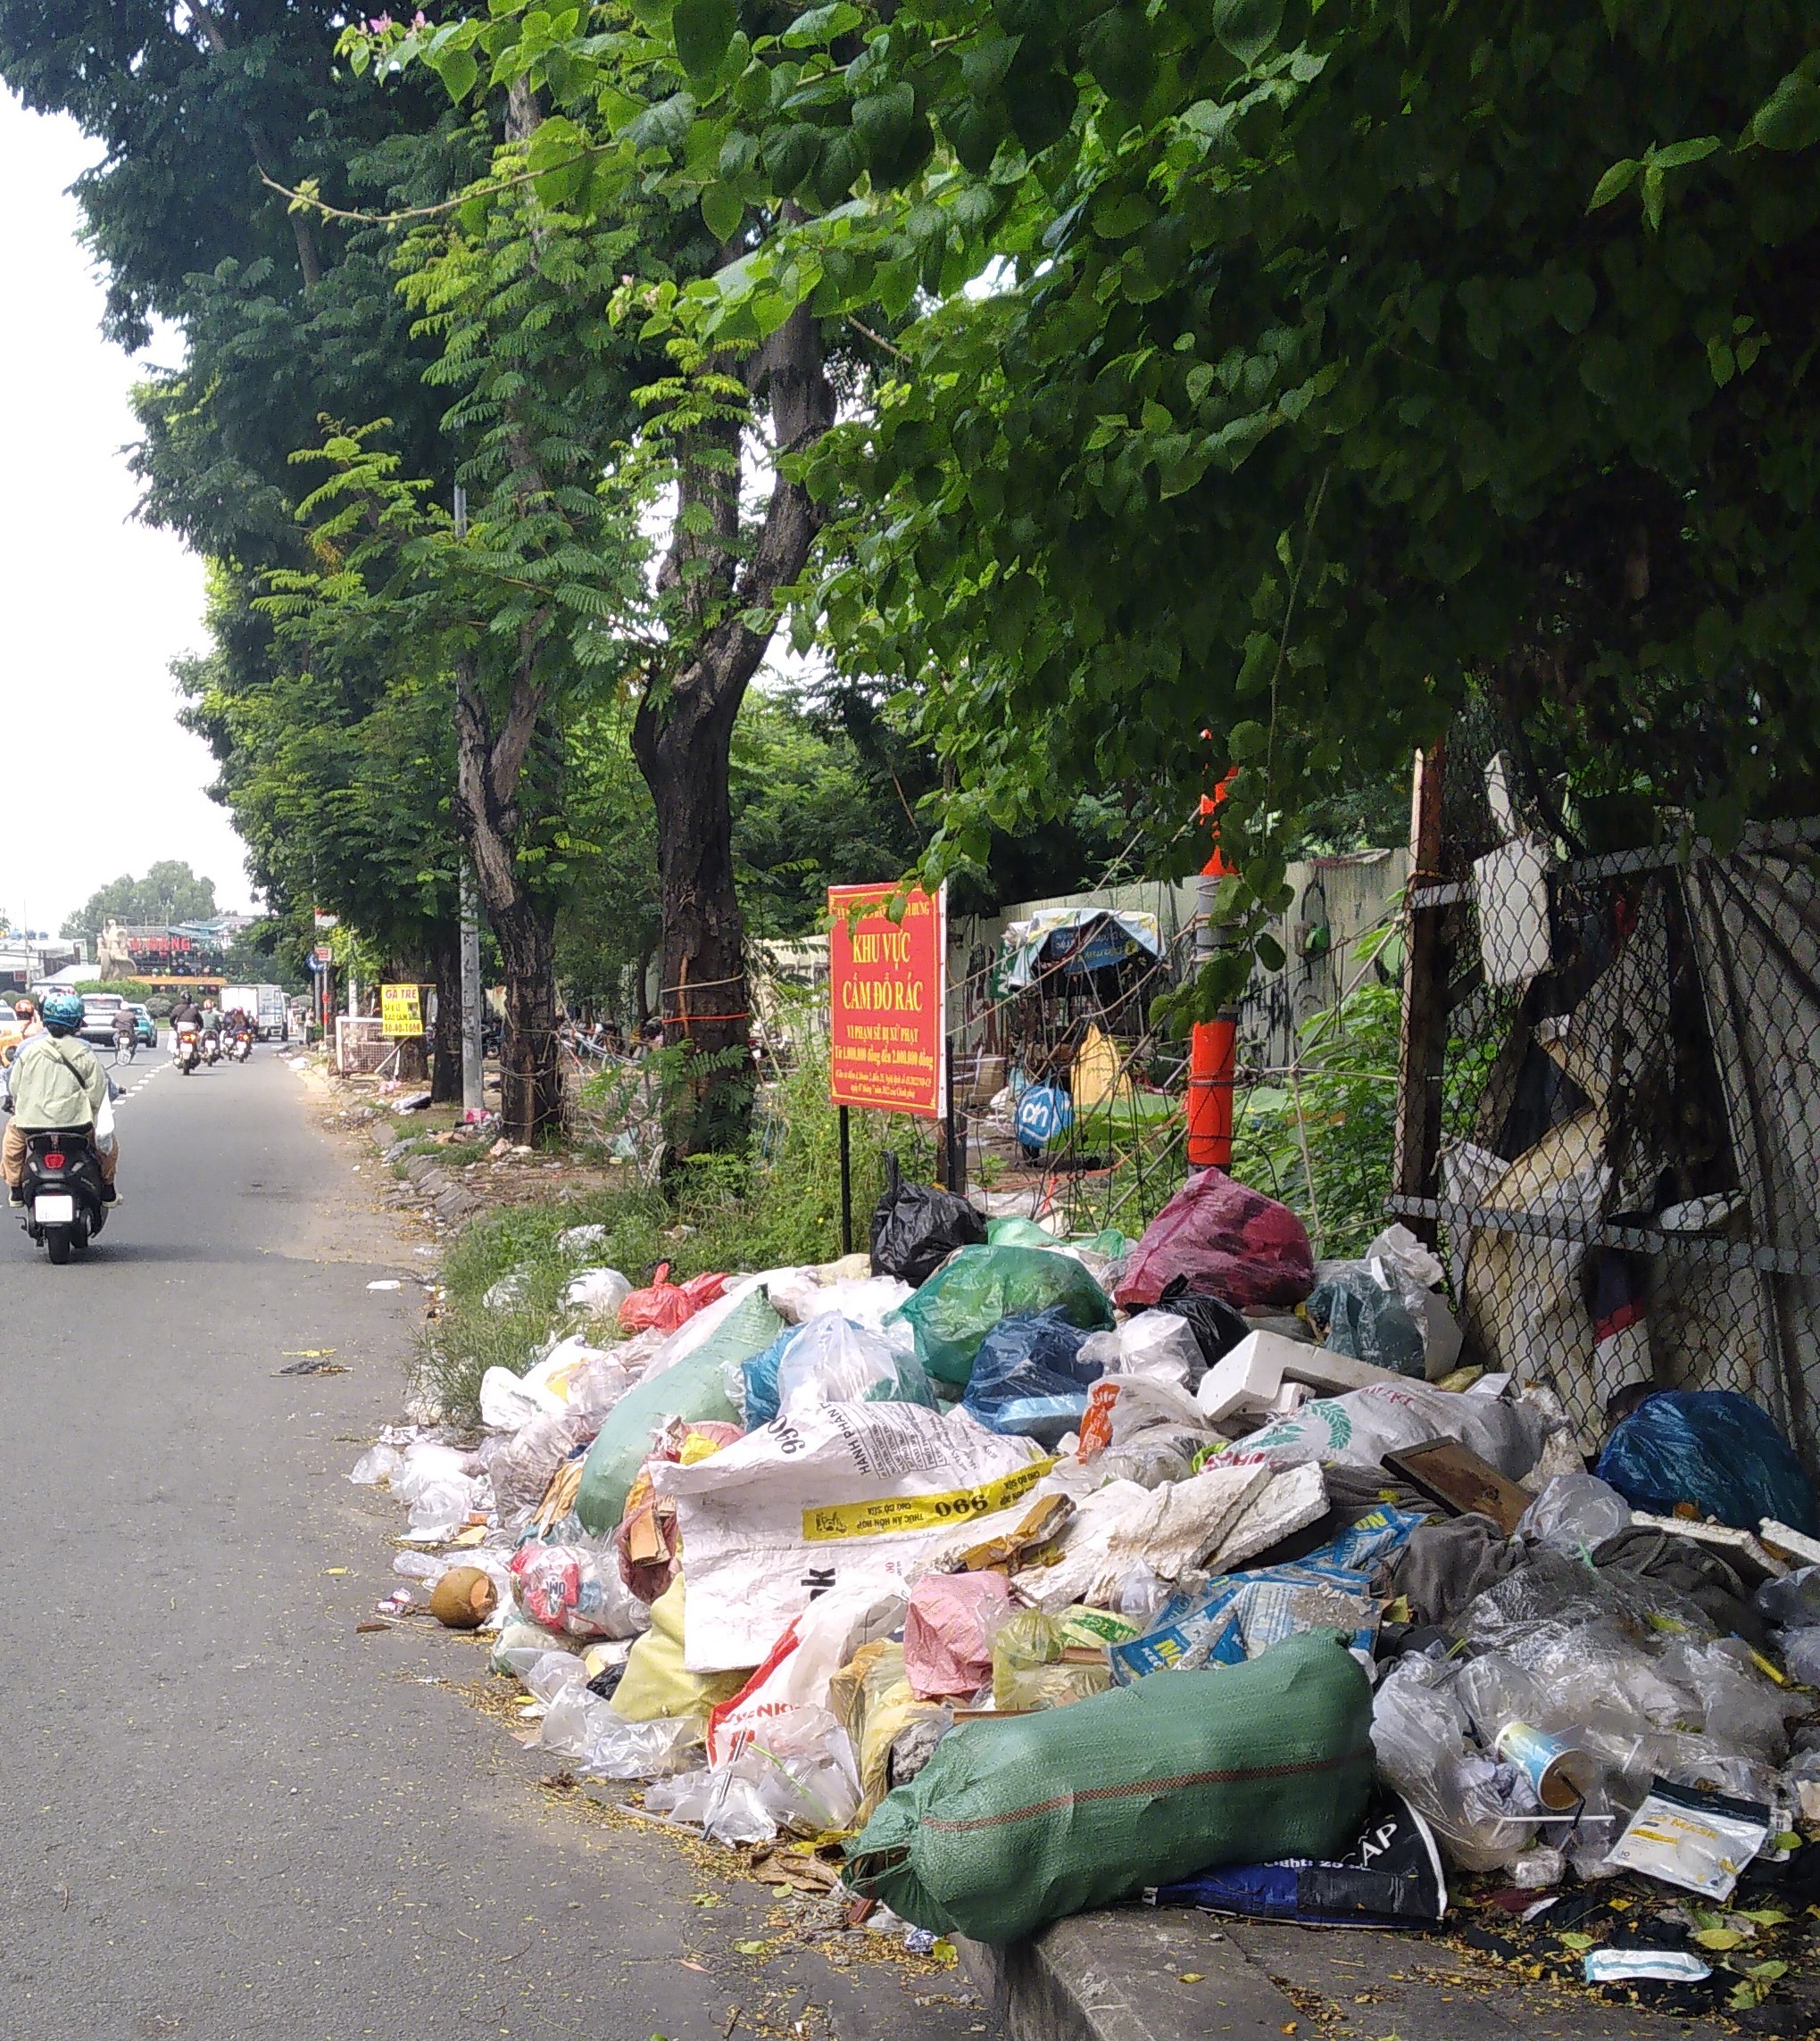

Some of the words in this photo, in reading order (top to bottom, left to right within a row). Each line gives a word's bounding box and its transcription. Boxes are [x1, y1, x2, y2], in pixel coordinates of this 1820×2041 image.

[852, 933, 880, 963] KHU
[882, 928, 910, 971] VỰC
[843, 972, 871, 1010] CẤM
[874, 972, 893, 1011] ĐỔ
[894, 971, 924, 1012] RÁC
[935, 1496, 987, 1515] 990
